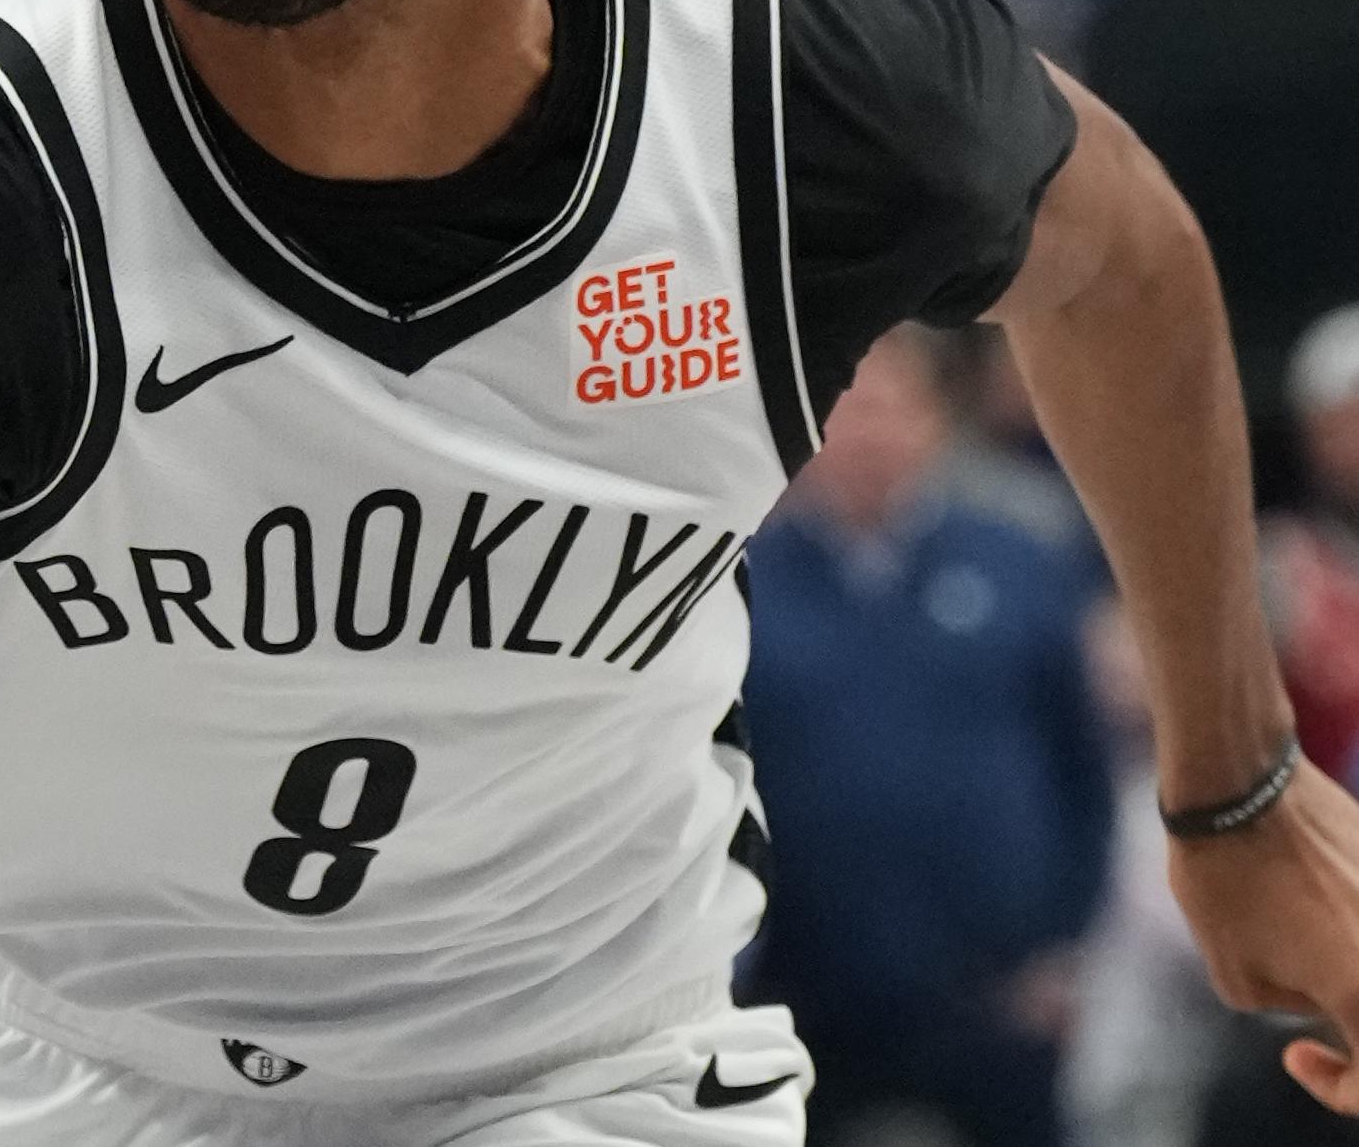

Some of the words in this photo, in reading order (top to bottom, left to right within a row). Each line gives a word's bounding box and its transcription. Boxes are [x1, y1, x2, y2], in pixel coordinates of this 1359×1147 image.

[577, 261, 676, 318] GET
[578, 298, 732, 361] YOUR
[576, 337, 741, 404] GUIDE
[14, 488, 753, 672] BROOKLYN
[243, 737, 418, 917] 8
